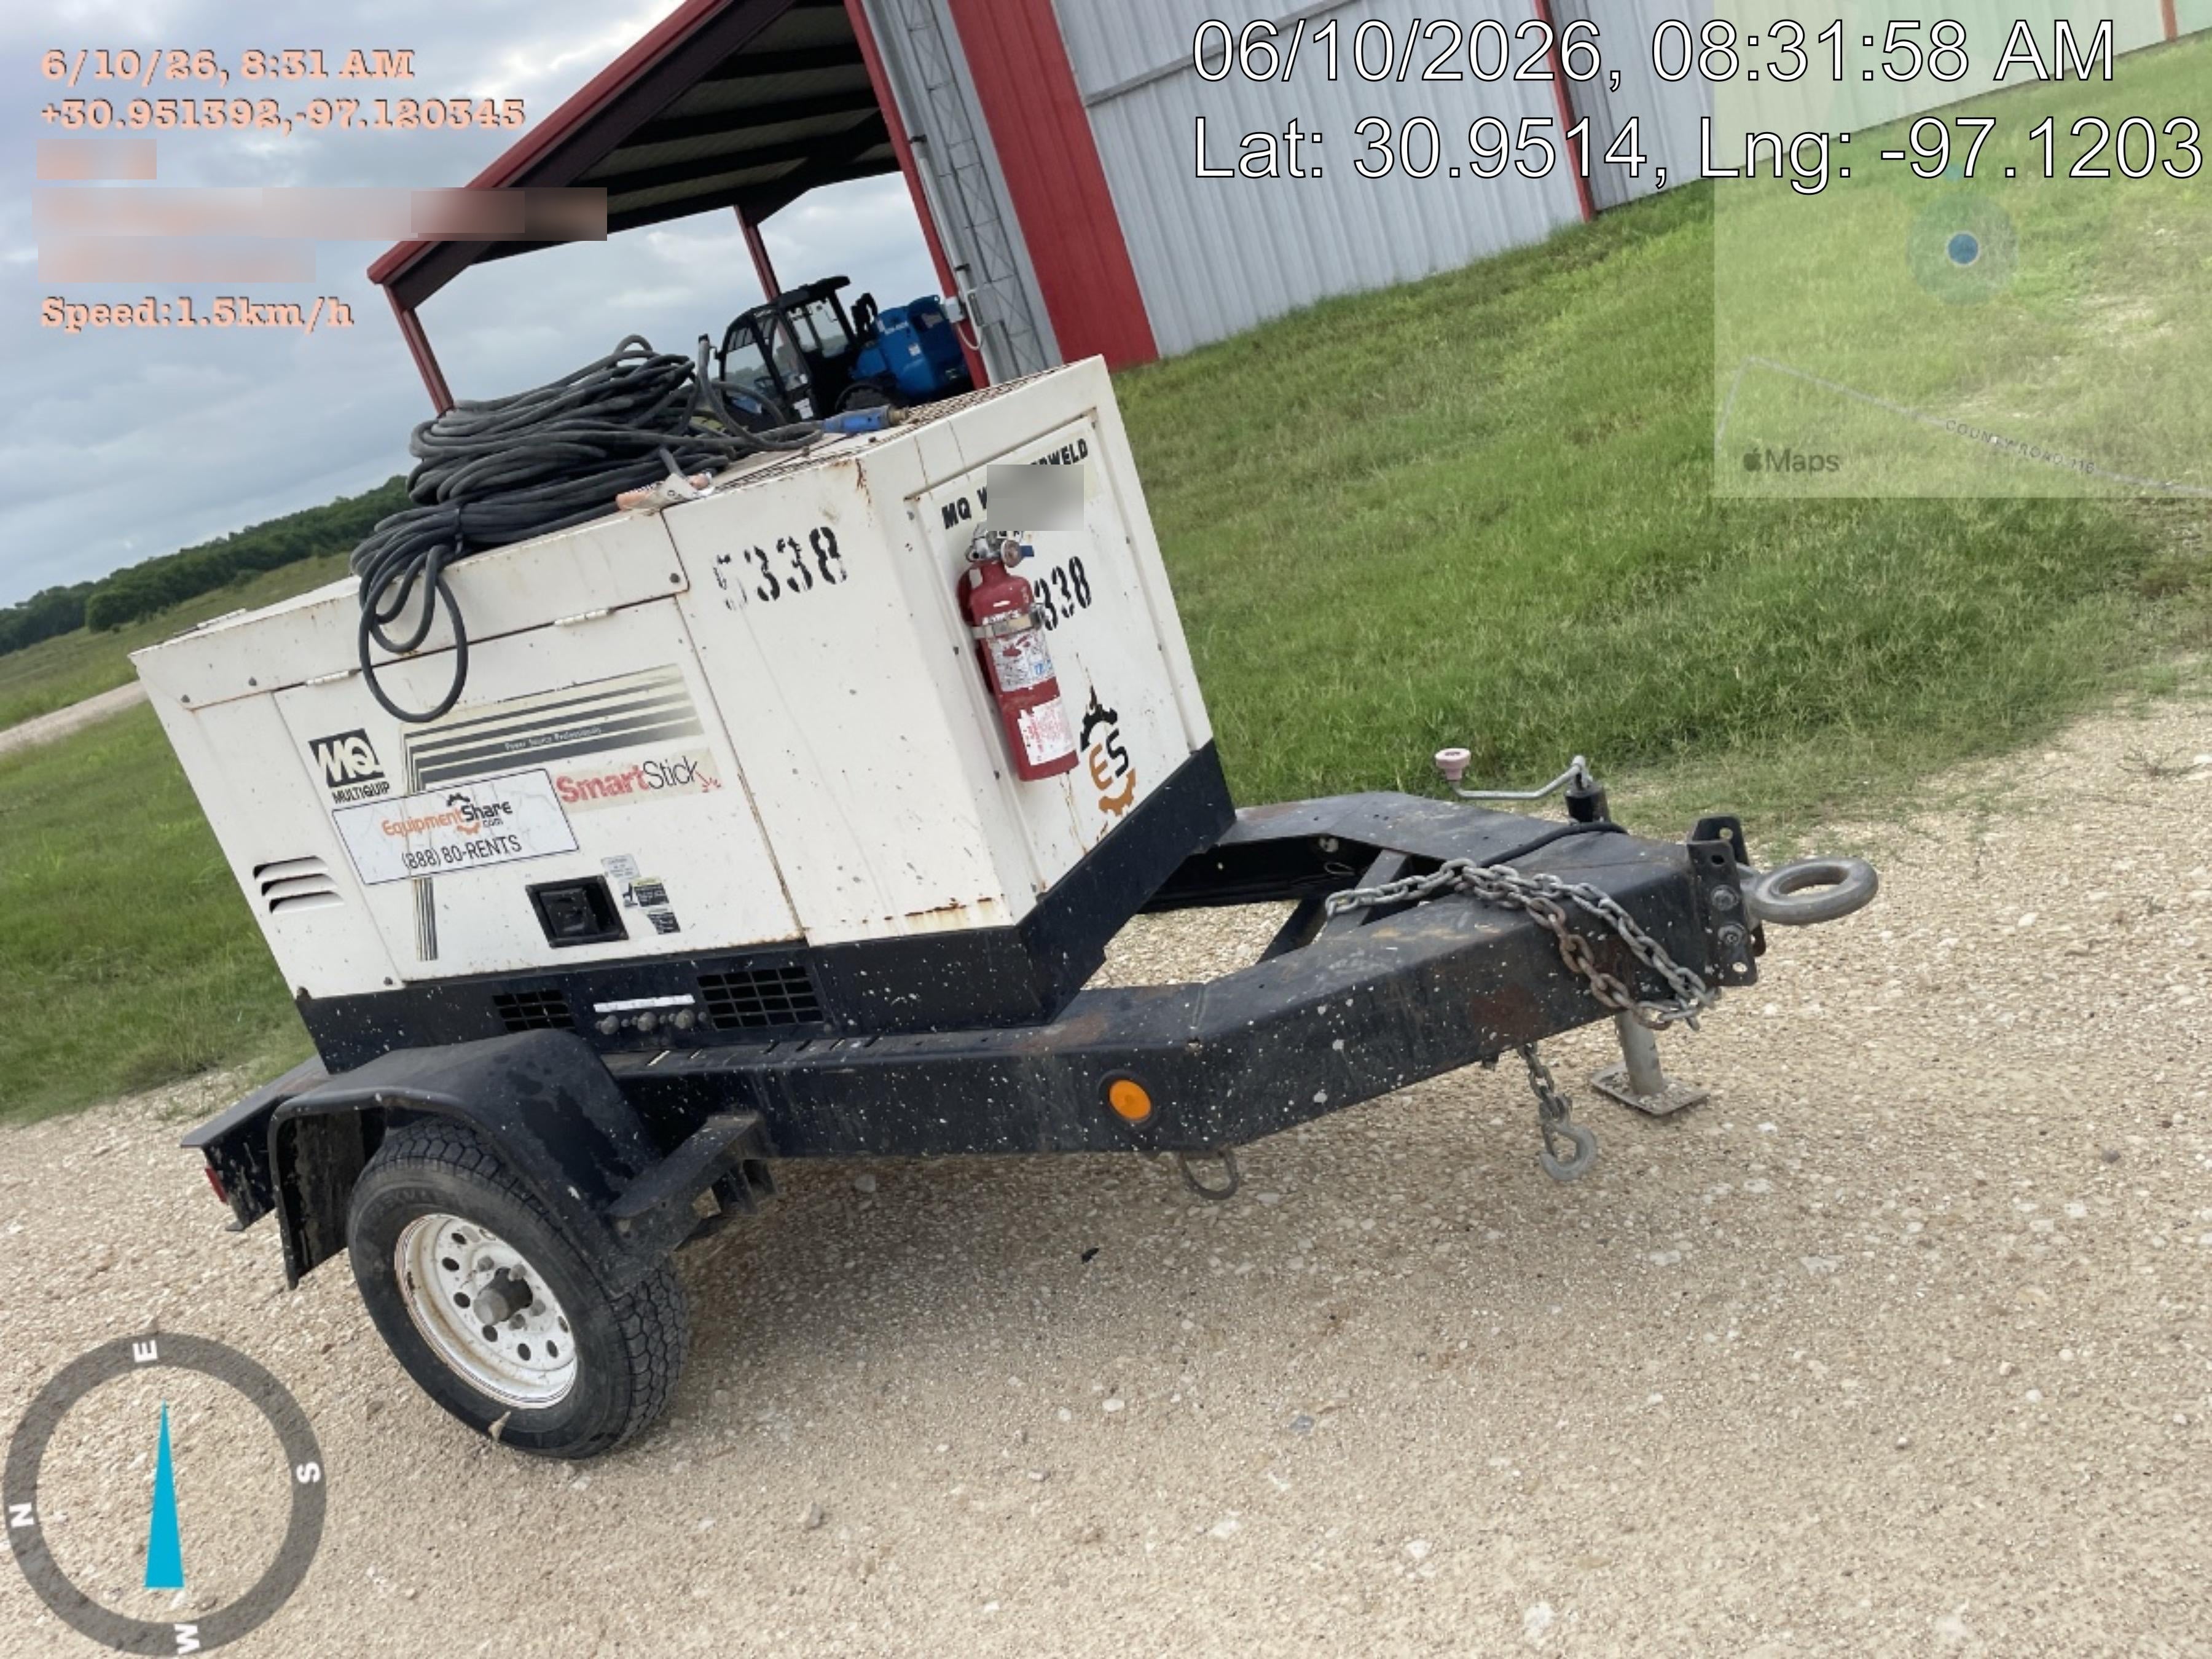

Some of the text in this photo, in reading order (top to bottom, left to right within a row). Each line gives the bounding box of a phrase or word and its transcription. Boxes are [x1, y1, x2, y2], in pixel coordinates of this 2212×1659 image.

[941, 496, 972, 530] MQ
[1034, 556, 1091, 630] 338
[332, 781, 390, 804] MULTIQUIP
[382, 801, 512, 837] EquipmentShare
[402, 834, 522, 869] (888) 80-RENTS
